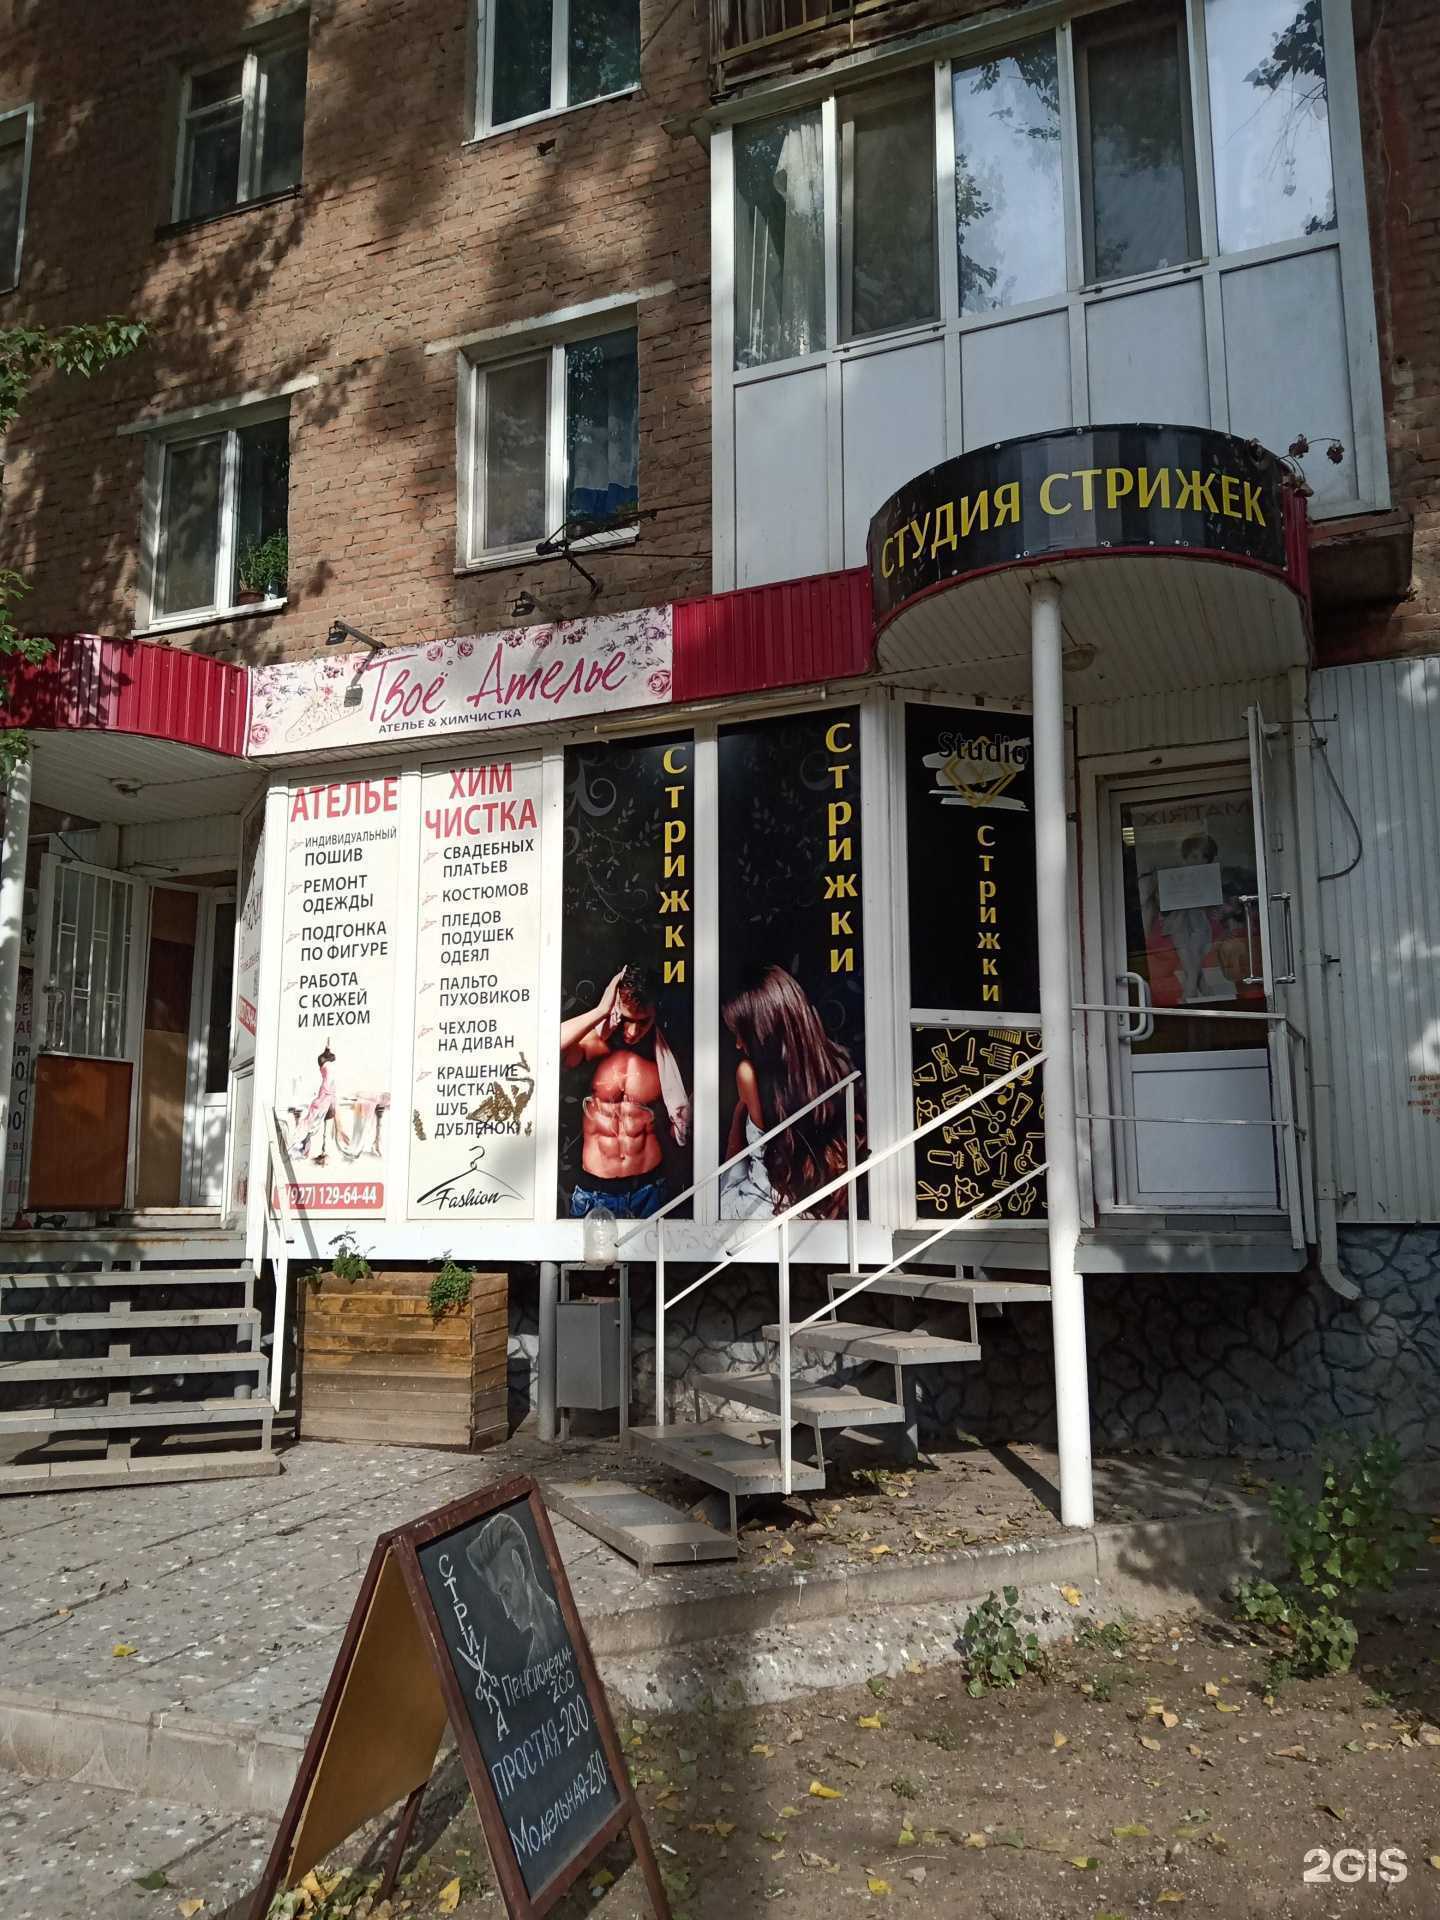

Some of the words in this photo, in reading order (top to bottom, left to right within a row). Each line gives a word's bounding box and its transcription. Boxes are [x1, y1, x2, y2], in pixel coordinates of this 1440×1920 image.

[881, 481, 1020, 579] СТУДИЯ
[1039, 467, 1267, 528] СТРИЖЕК
[368, 654, 449, 722] Твоё
[467, 643, 629, 708] Ателье
[378, 719, 425, 734] АТЕЛЬЕ
[427, 719, 437, 728] &
[440, 707, 522, 727] ХИМЧИСТКА
[938, 731, 1029, 765] Studio
[449, 762, 512, 800] ХИМ
[290, 776, 398, 823] АТЕЛЬЕ
[424, 798, 538, 839] ЧИСТКА
[304, 826, 397, 848] ИНДИВИДУАЛЬНЫЙ
[304, 847, 363, 867] ПОШИВ
[443, 838, 535, 861] СВАДЕБНЫХ
[443, 859, 508, 879] ПЛАТЬЕВ
[303, 874, 368, 894] РЕМОНТ
[442, 883, 529, 903] КОСТЮМОВ
[302, 893, 374, 915] ОДЕЖДЫ
[441, 909, 502, 929] ПЛЕДОВ
[301, 920, 387, 943] ПОДГОНКА
[441, 928, 515, 947] ПОДУШЕК
[300, 949, 323, 962] ПО
[326, 941, 389, 960] ФИГУРЕ
[440, 948, 490, 966] ОДЕЯЛ
[299, 971, 358, 990] РАБОТА
[440, 974, 498, 991] ПАЛЬТО
[298, 995, 309, 1009] С
[312, 988, 368, 1008] КОЖЕЙ
[439, 988, 531, 1008] ПУХОВИКОВ
[298, 1013, 309, 1028] И
[312, 1009, 371, 1027] МЕХОМ
[439, 1019, 498, 1036] ЧЕХЛОВ
[438, 1038, 459, 1052] НА
[462, 1035, 515, 1054] ДИВАН
[437, 1064, 518, 1080] КРАШЕНИЕ
[437, 1082, 495, 1097] ЧИСТКА
[436, 1102, 469, 1116] ШУБ
[318, 1185, 377, 1205] 129-64-44
[432, 1186, 502, 1211] Fashion
